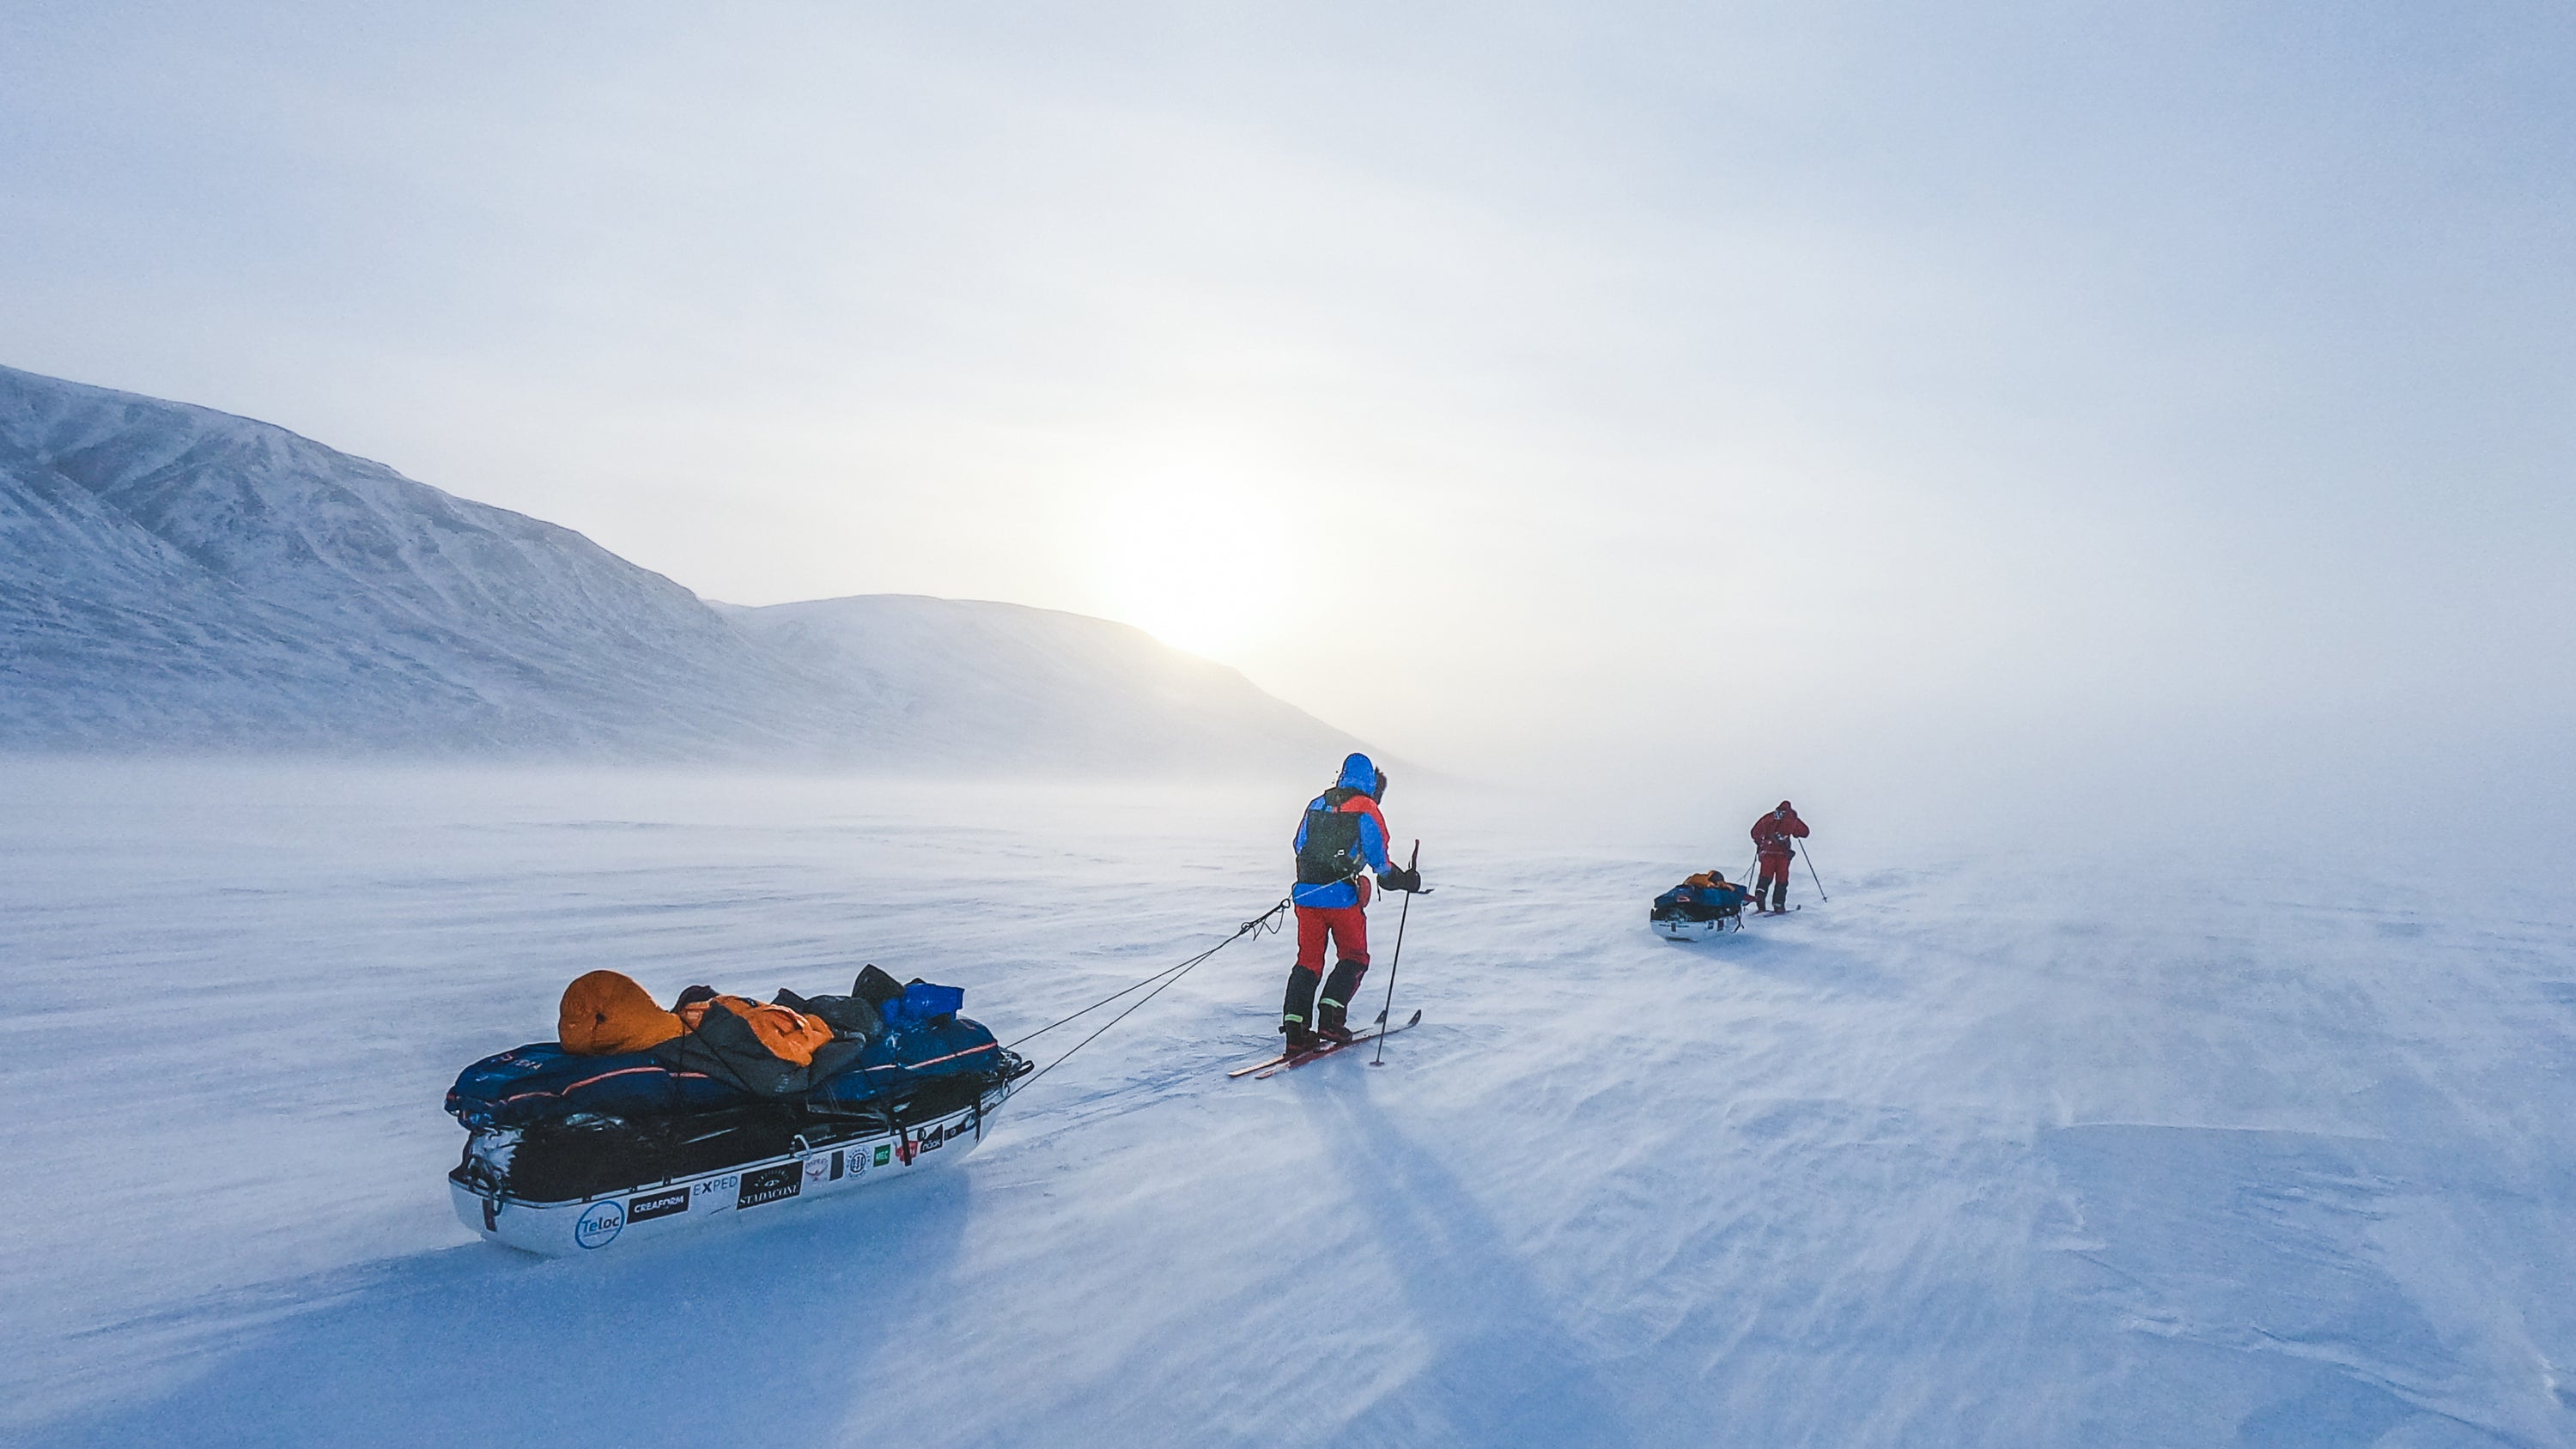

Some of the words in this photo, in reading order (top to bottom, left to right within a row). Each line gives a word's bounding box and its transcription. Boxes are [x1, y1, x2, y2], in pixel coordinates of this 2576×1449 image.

[693, 1176, 738, 1197] EXPED
[635, 1195, 684, 1213] CREAFORM
[582, 1216, 620, 1234] Teloc
